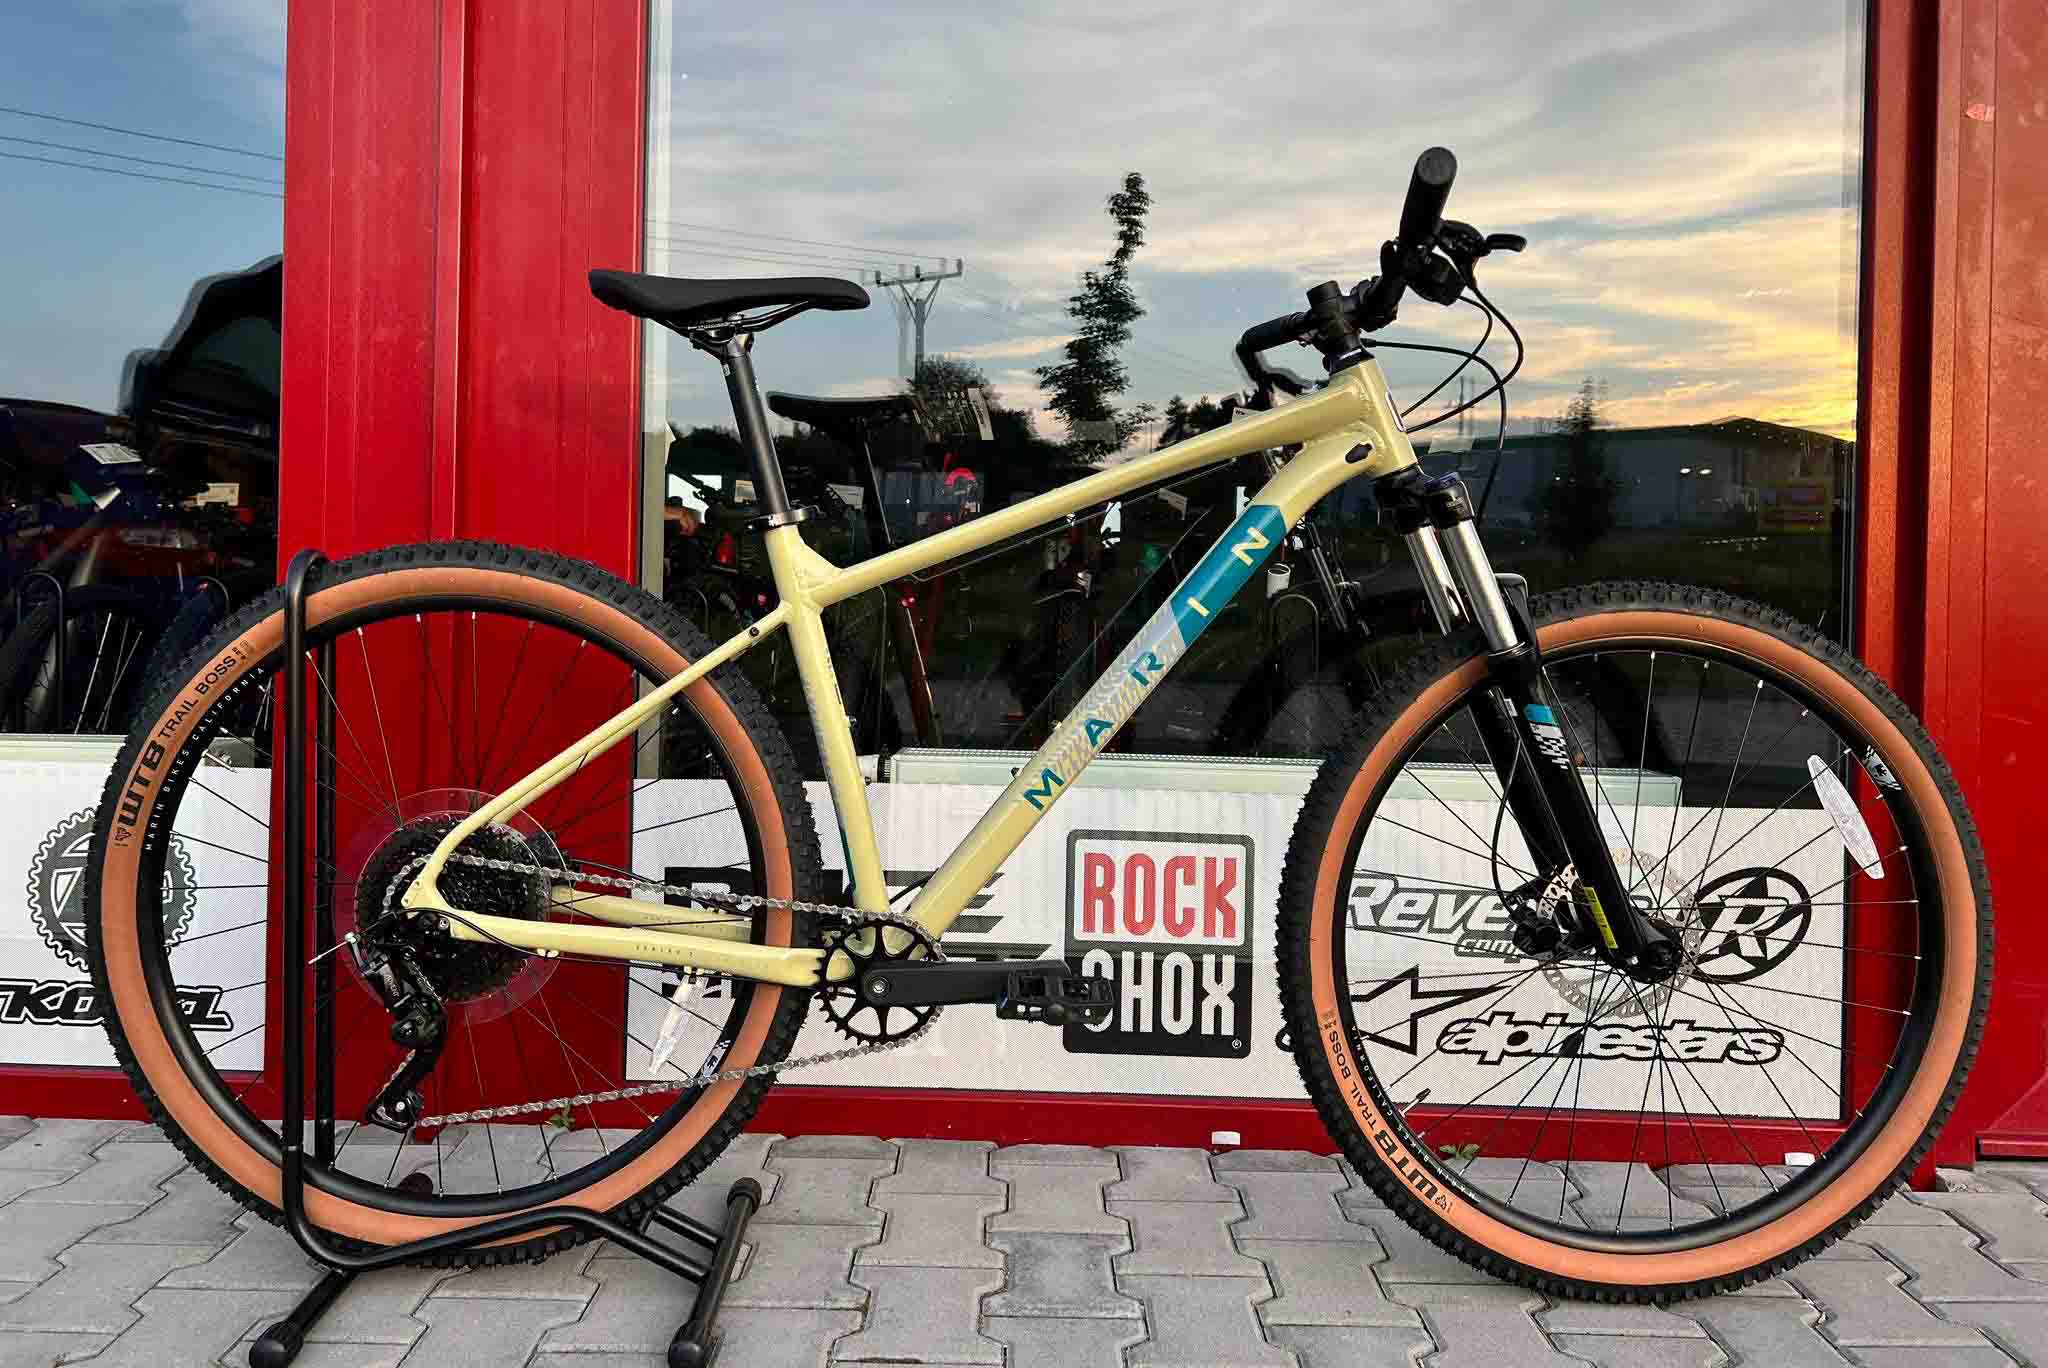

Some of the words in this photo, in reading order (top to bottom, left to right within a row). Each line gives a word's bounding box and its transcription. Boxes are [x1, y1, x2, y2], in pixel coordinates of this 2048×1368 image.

[158, 697, 199, 739] TRAIL
[195, 655, 237, 696] BOSS
[1023, 527, 1271, 811] MARIN
[145, 803, 165, 851] MARIN
[162, 749, 190, 793] BIKES
[192, 666, 265, 742] CALIFORNIA
[1082, 852, 1238, 939] ROCK
[1329, 1030, 1352, 1080] BOSS
[1350, 1082, 1378, 1131] TRAIL
